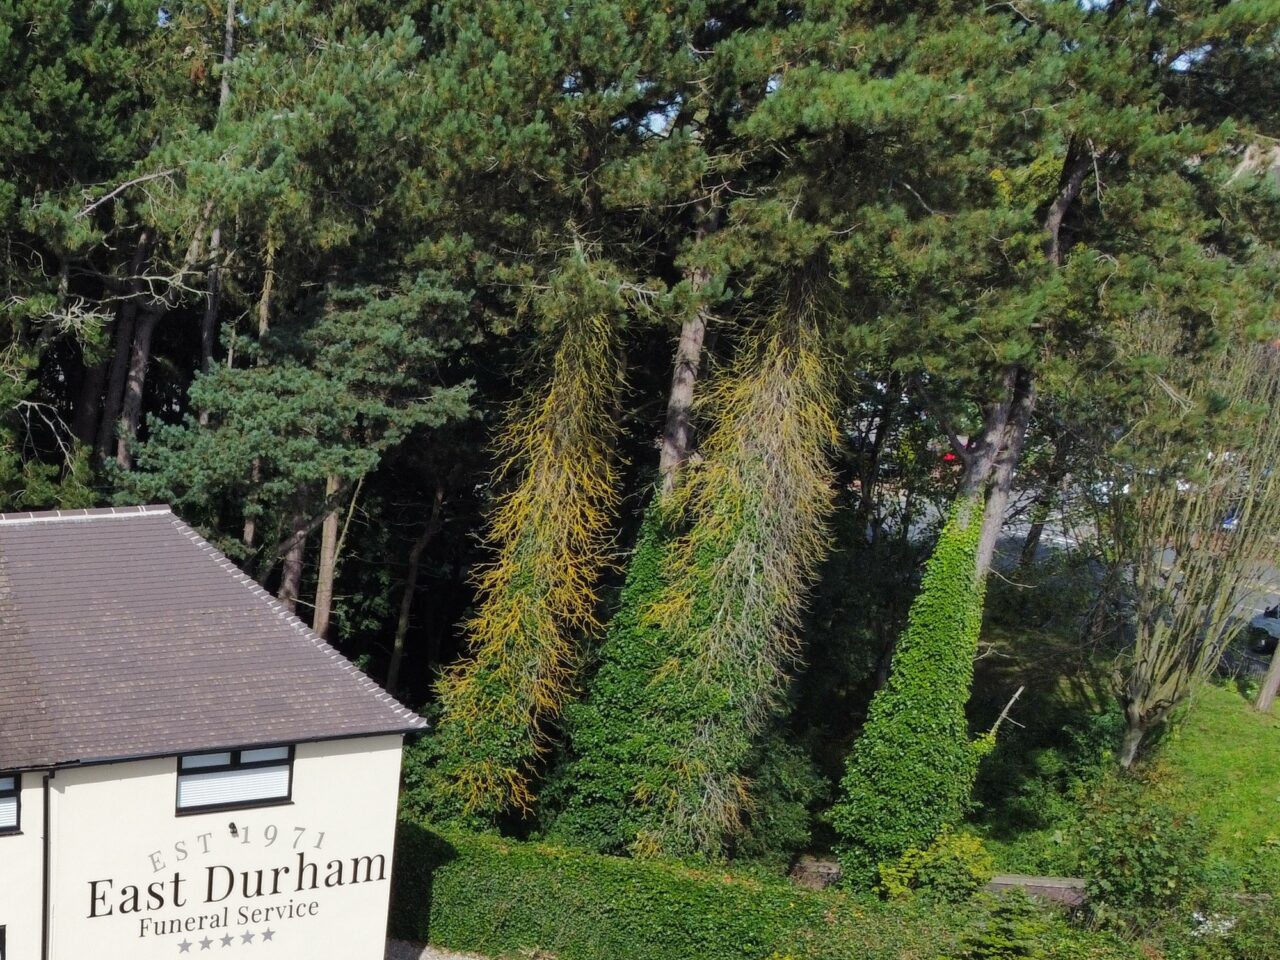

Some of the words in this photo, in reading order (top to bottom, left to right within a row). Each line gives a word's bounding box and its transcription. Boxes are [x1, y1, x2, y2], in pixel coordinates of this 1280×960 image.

[148, 832, 213, 873] EST
[240, 824, 326, 850] 1971
[86, 871, 188, 919] East
[203, 851, 387, 904] Durham
[138, 907, 229, 938] Funeral
[236, 898, 320, 927] Service
